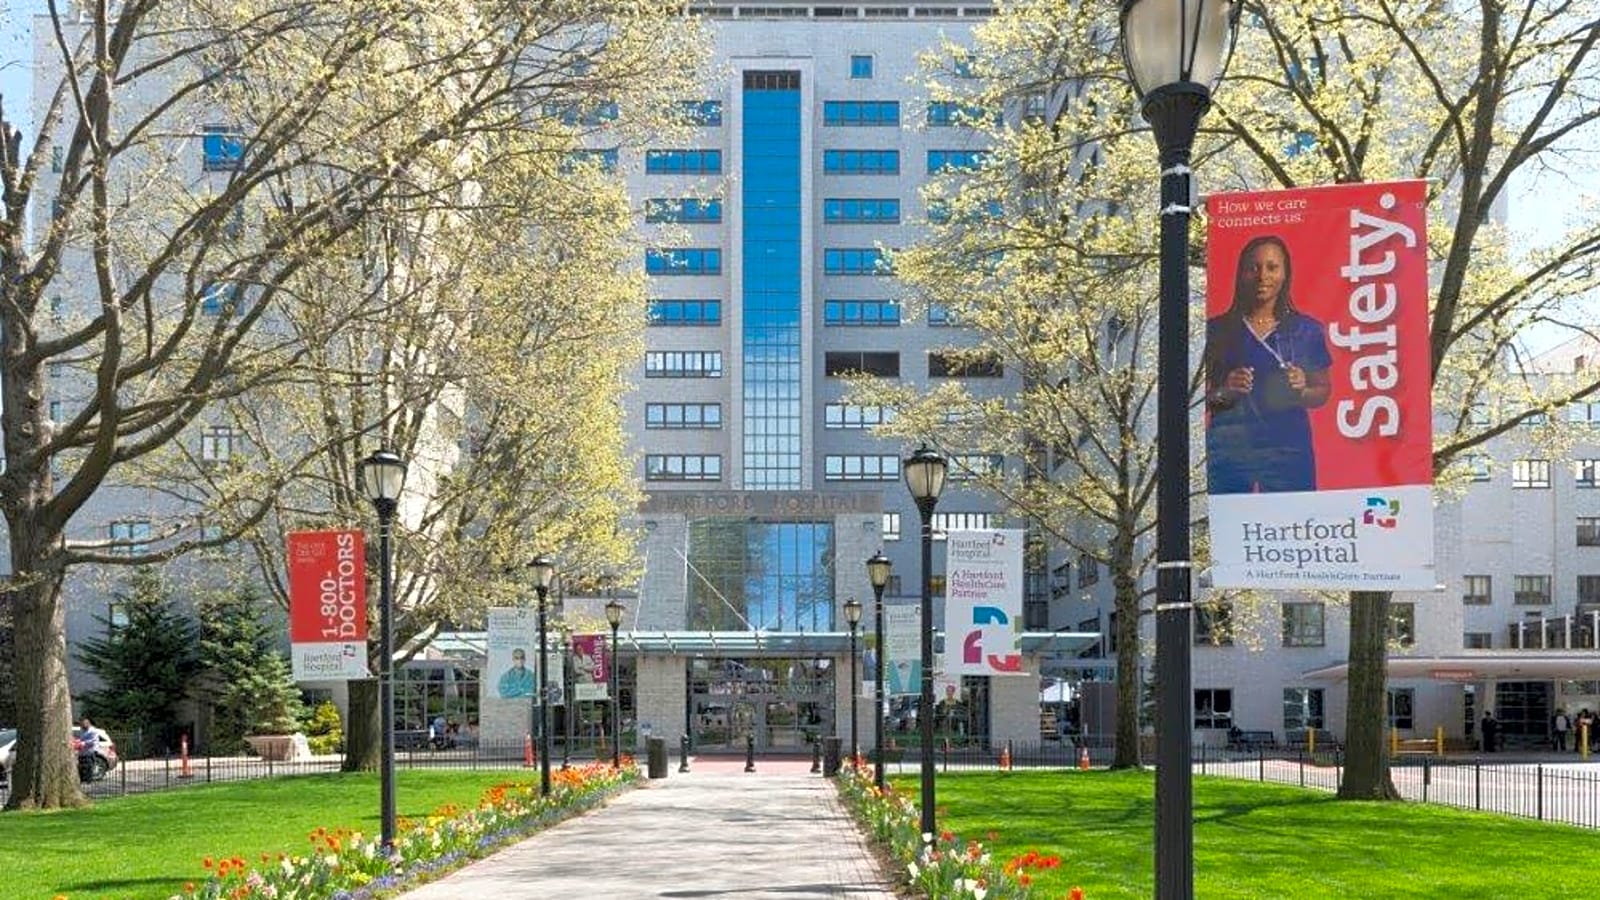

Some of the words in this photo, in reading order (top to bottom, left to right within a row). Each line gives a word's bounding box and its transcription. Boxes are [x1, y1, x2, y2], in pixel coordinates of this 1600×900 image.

[1218, 201, 1249, 214] How
[1254, 201, 1273, 211] we
[1277, 199, 1307, 210] care
[1218, 214, 1281, 228] connects
[1285, 213, 1304, 224] us.
[1329, 193, 1416, 438] Safety.
[1242, 517, 1358, 541] Hartford
[1244, 542, 1359, 569] Hospital
[337, 533, 357, 638] DOCTORS
[1256, 570, 1300, 579] Hartford
[320, 570, 338, 638] 1-800-
